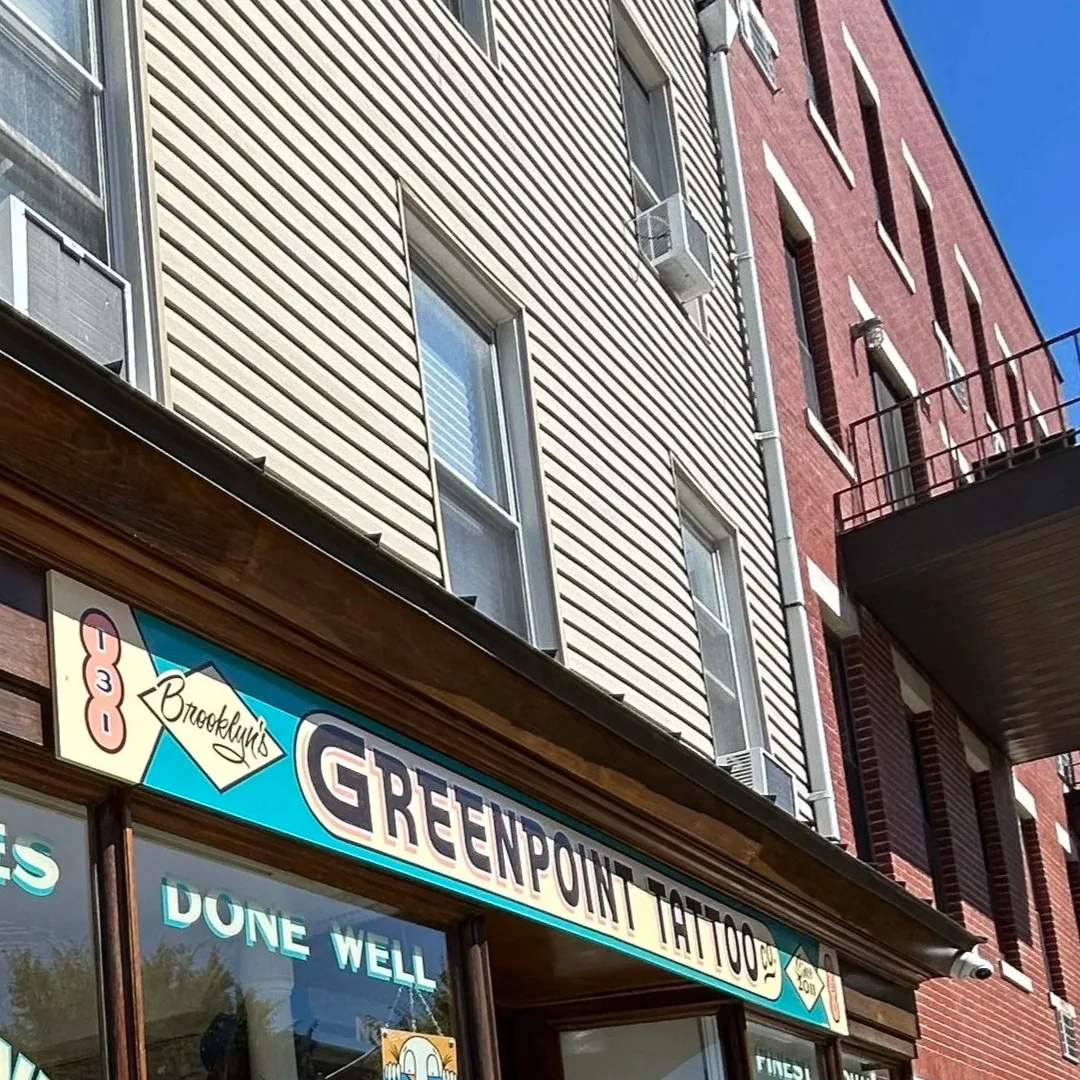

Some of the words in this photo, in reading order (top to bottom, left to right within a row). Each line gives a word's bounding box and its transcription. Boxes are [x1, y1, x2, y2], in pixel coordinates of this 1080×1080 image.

[157, 673, 270, 769] Brooklyn's
[306, 721, 636, 936] GREENPOINT
[647, 876, 761, 984] TATTOO
[161, 877, 311, 961] DONE
[330, 920, 438, 993] WELL
